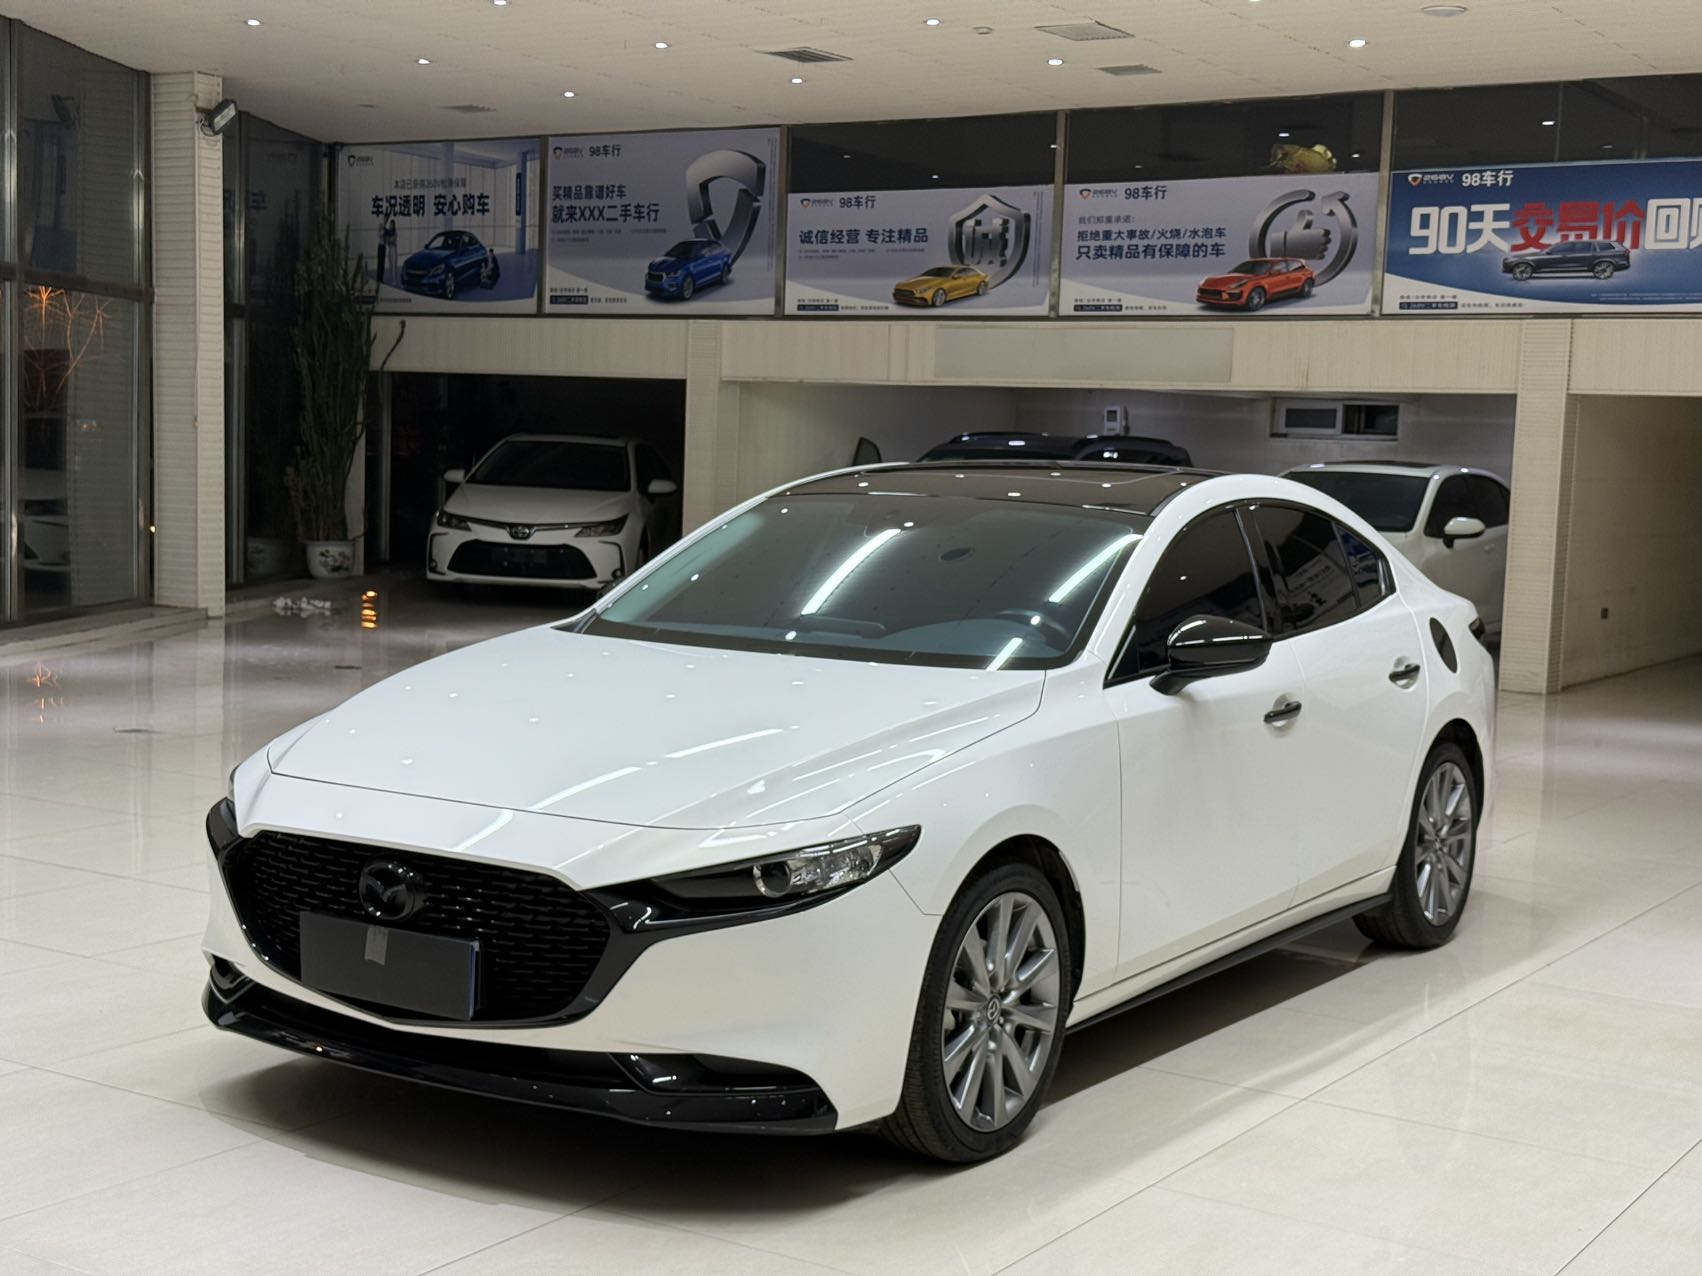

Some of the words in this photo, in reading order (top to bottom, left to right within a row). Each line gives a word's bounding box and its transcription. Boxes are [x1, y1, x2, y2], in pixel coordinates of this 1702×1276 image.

[589, 144, 622, 157] 98车行
[1461, 170, 1514, 187] 98车行
[552, 184, 627, 201] 买精品靠谱好车
[1124, 185, 1168, 201] 98车行
[371, 195, 425, 218] 车况透明
[433, 192, 490, 216] 安心购车
[839, 195, 877, 209] 98车行
[551, 203, 660, 223] 就来XXX二手车行
[1076, 227, 1228, 242] 拒绝重大事故/火烧/水泡车
[1409, 197, 1702, 256] 90天交易价回
[799, 229, 861, 245] 诚信经营
[866, 227, 929, 245] 专注精品
[1075, 243, 1226, 261] 只卖精品有保障的车
